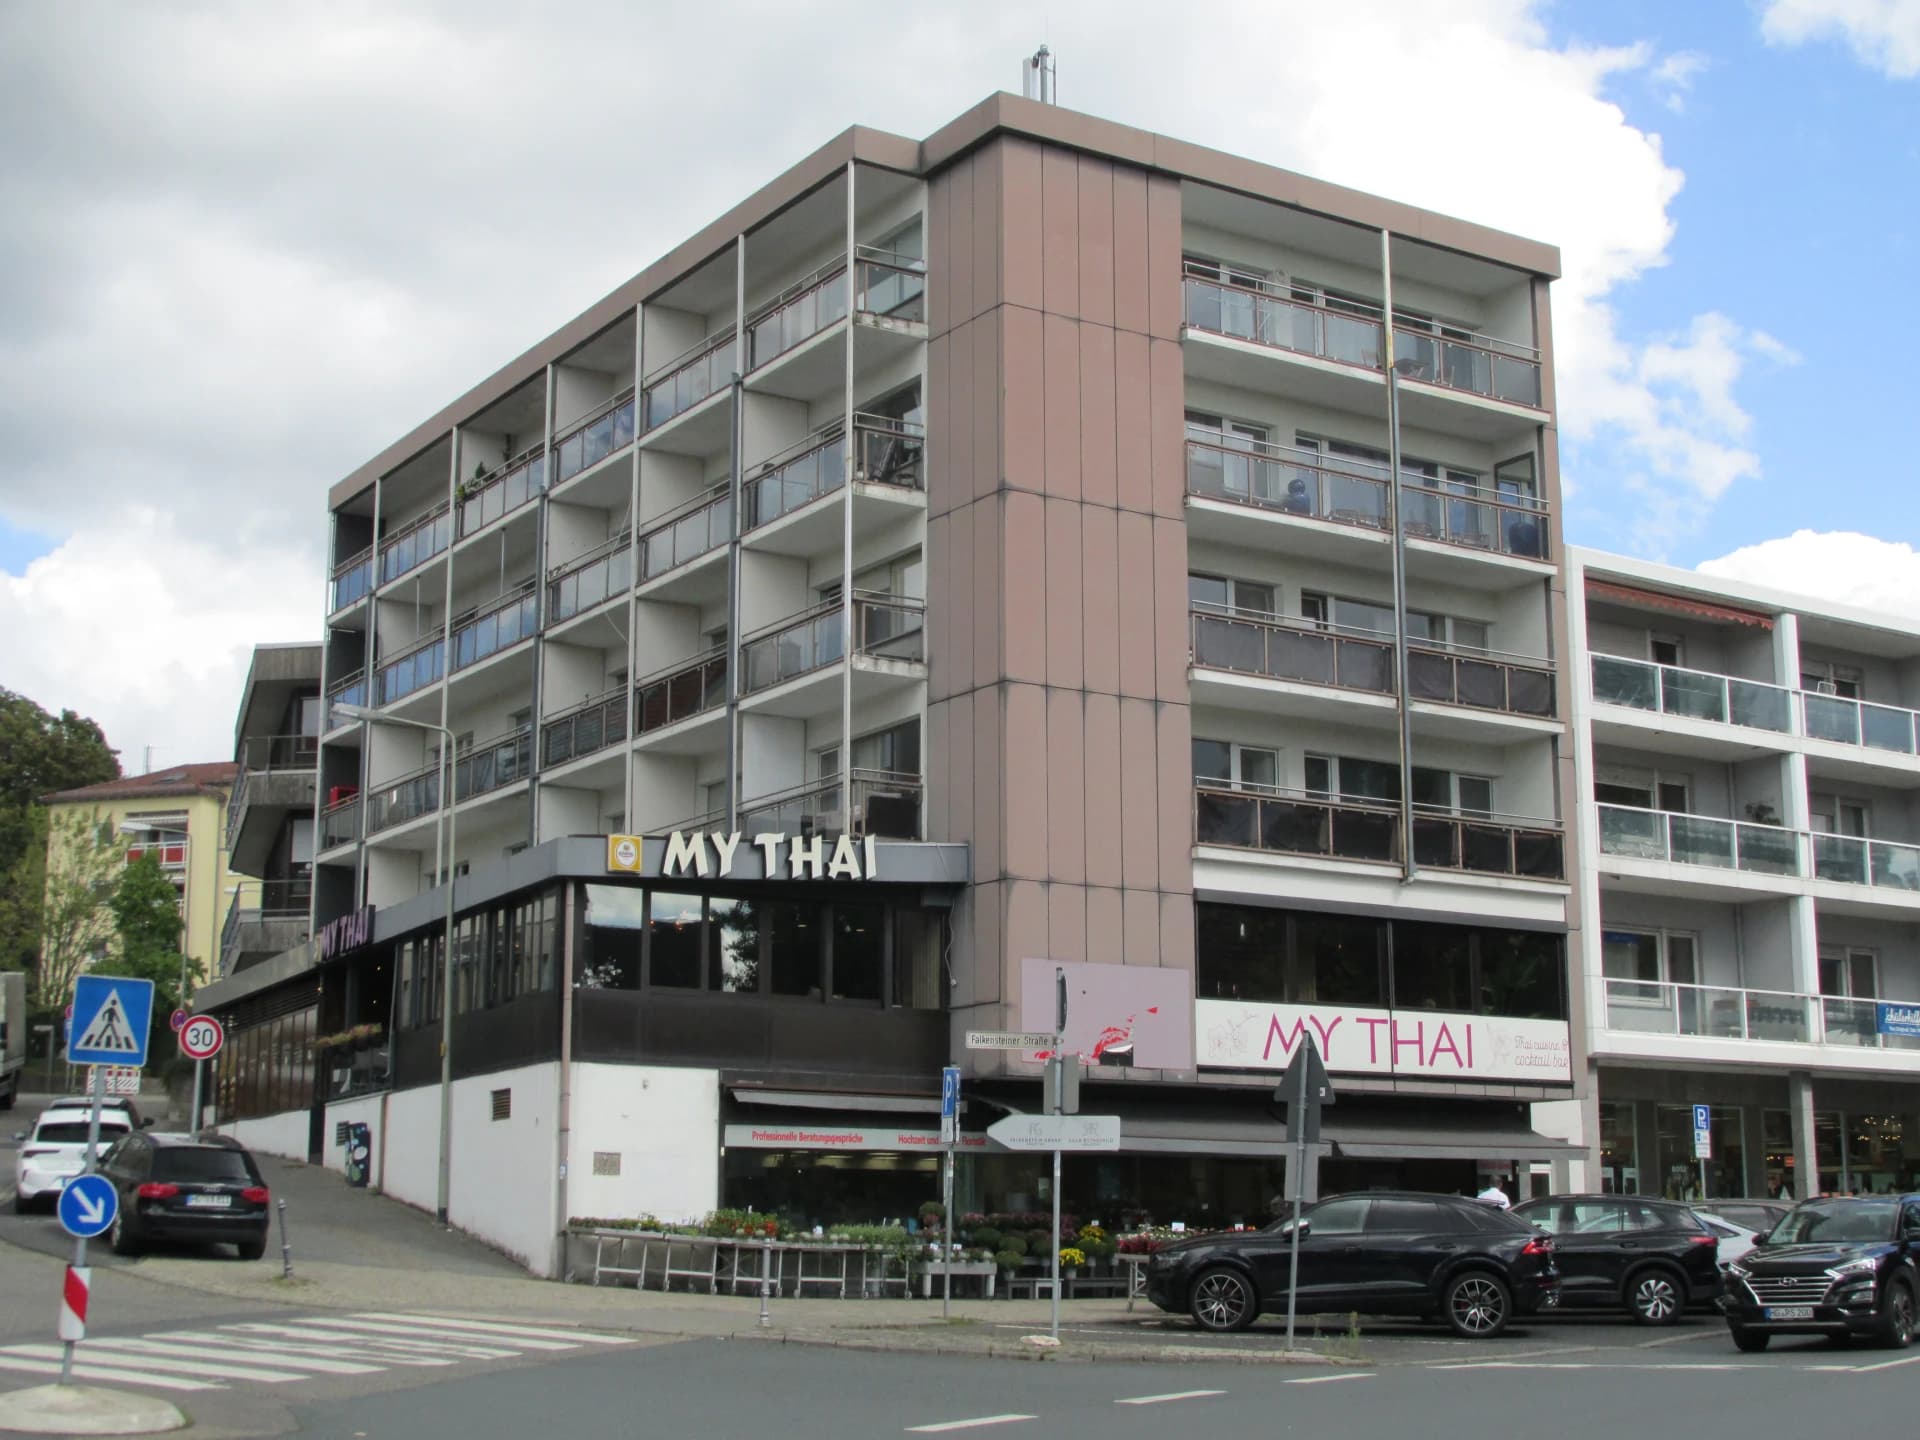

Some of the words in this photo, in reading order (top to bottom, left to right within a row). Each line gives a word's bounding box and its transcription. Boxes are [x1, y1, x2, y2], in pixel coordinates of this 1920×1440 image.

[663, 831, 742, 877] MY
[754, 832, 878, 880] THAI
[322, 918, 338, 959] MY
[340, 907, 369, 953] THAI
[189, 1027, 213, 1047] 30
[971, 1034, 1021, 1046] Falkensteiner
[1024, 1035, 1049, 1046] Straße
[1263, 1012, 1343, 1062] MY
[1356, 1017, 1473, 1069] THAI
[752, 1130, 797, 1142] Professionelle
[799, 1131, 864, 1145] Beratungsgespräche
[898, 1134, 926, 1145] Hochzeit
[927, 1135, 939, 1145] und
